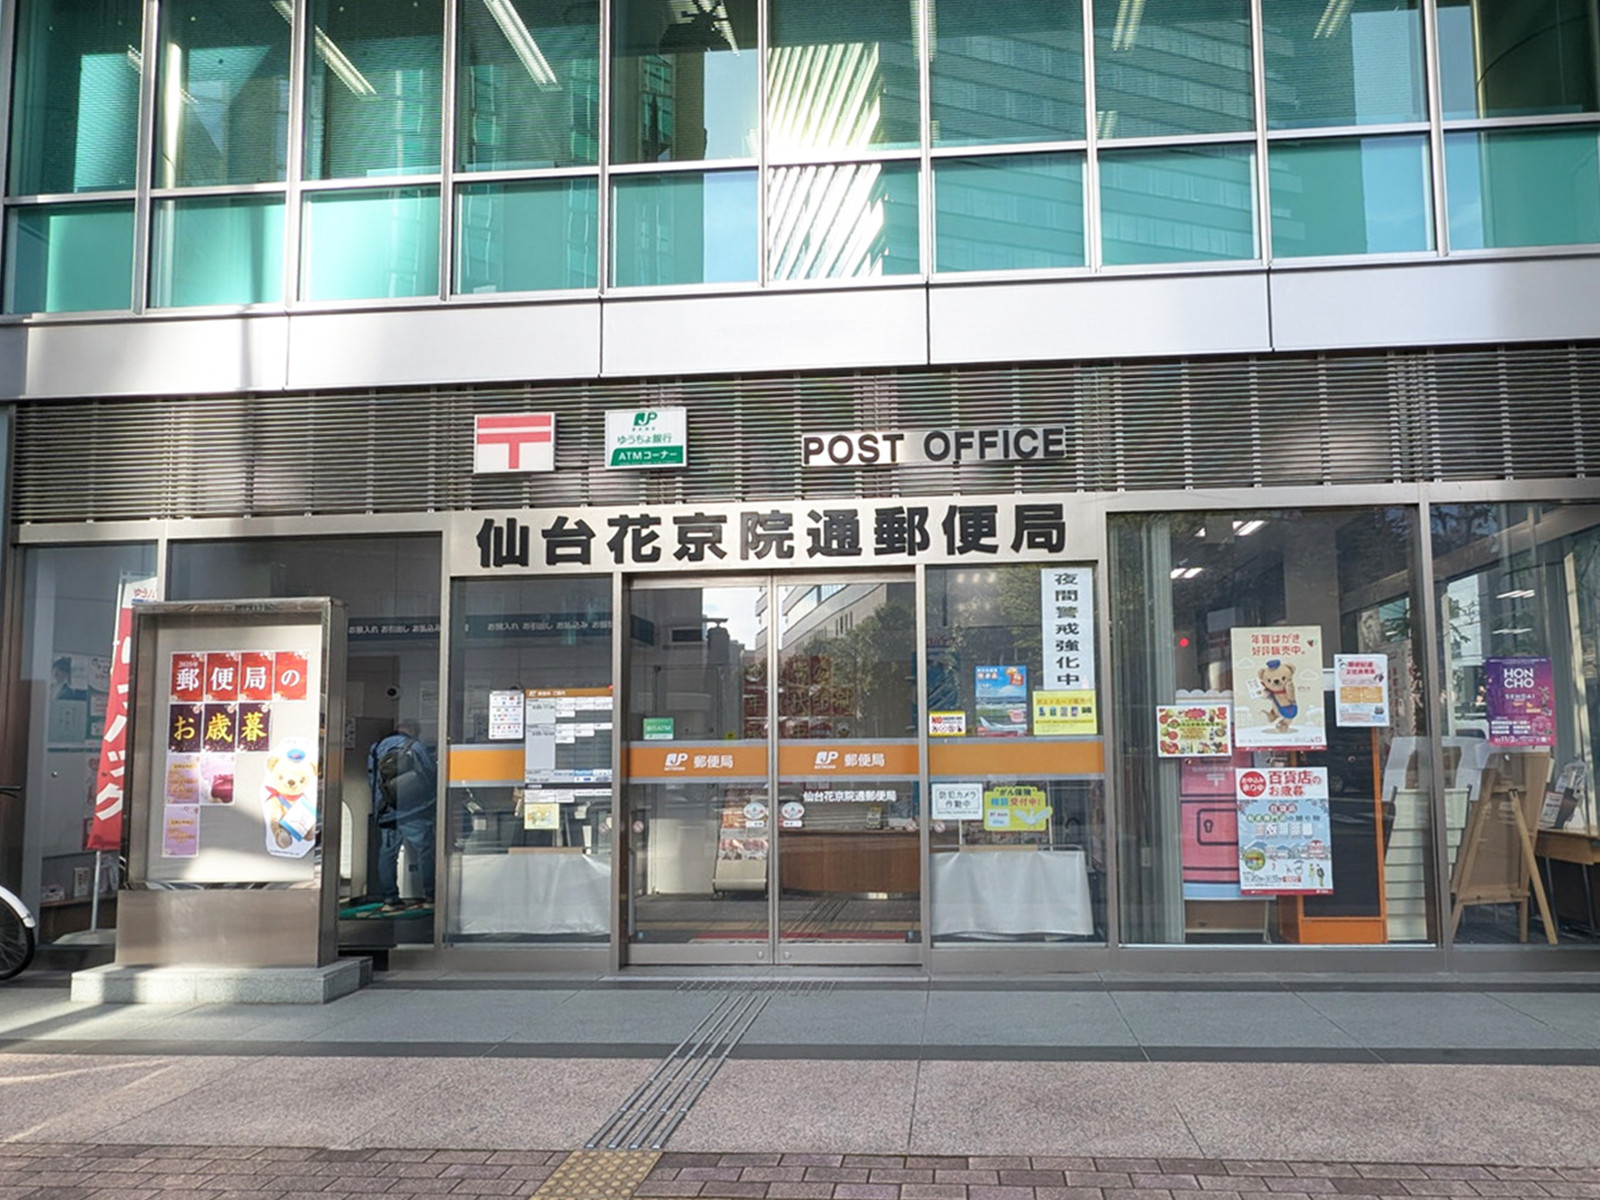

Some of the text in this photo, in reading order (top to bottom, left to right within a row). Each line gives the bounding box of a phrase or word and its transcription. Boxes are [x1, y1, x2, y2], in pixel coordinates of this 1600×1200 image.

[617, 433, 672, 445] ゆうちょ銀行
[803, 428, 1066, 465] POST OFFICE
[618, 450, 678, 461] ATMコーナー
[476, 503, 1066, 568] 仙台花京院通郵便局
[1054, 572, 1080, 686] 夜間警戒強化中
[1251, 634, 1300, 645] 年賀はがき
[176, 666, 300, 692] 郵便局の
[1503, 667, 1534, 679] HON
[1503, 678, 1535, 689] CHO
[173, 711, 267, 743] お歳暮
[693, 754, 734, 769] 郵便局
[844, 753, 885, 767] 郵便局
[1268, 770, 1322, 785] 百貨店の
[803, 790, 897, 802] 仙台花京院通郵便局
[938, 791, 977, 799] 防犯カメラ
[1000, 788, 1031, 796] がん保険
[945, 800, 971, 808] 作動中
